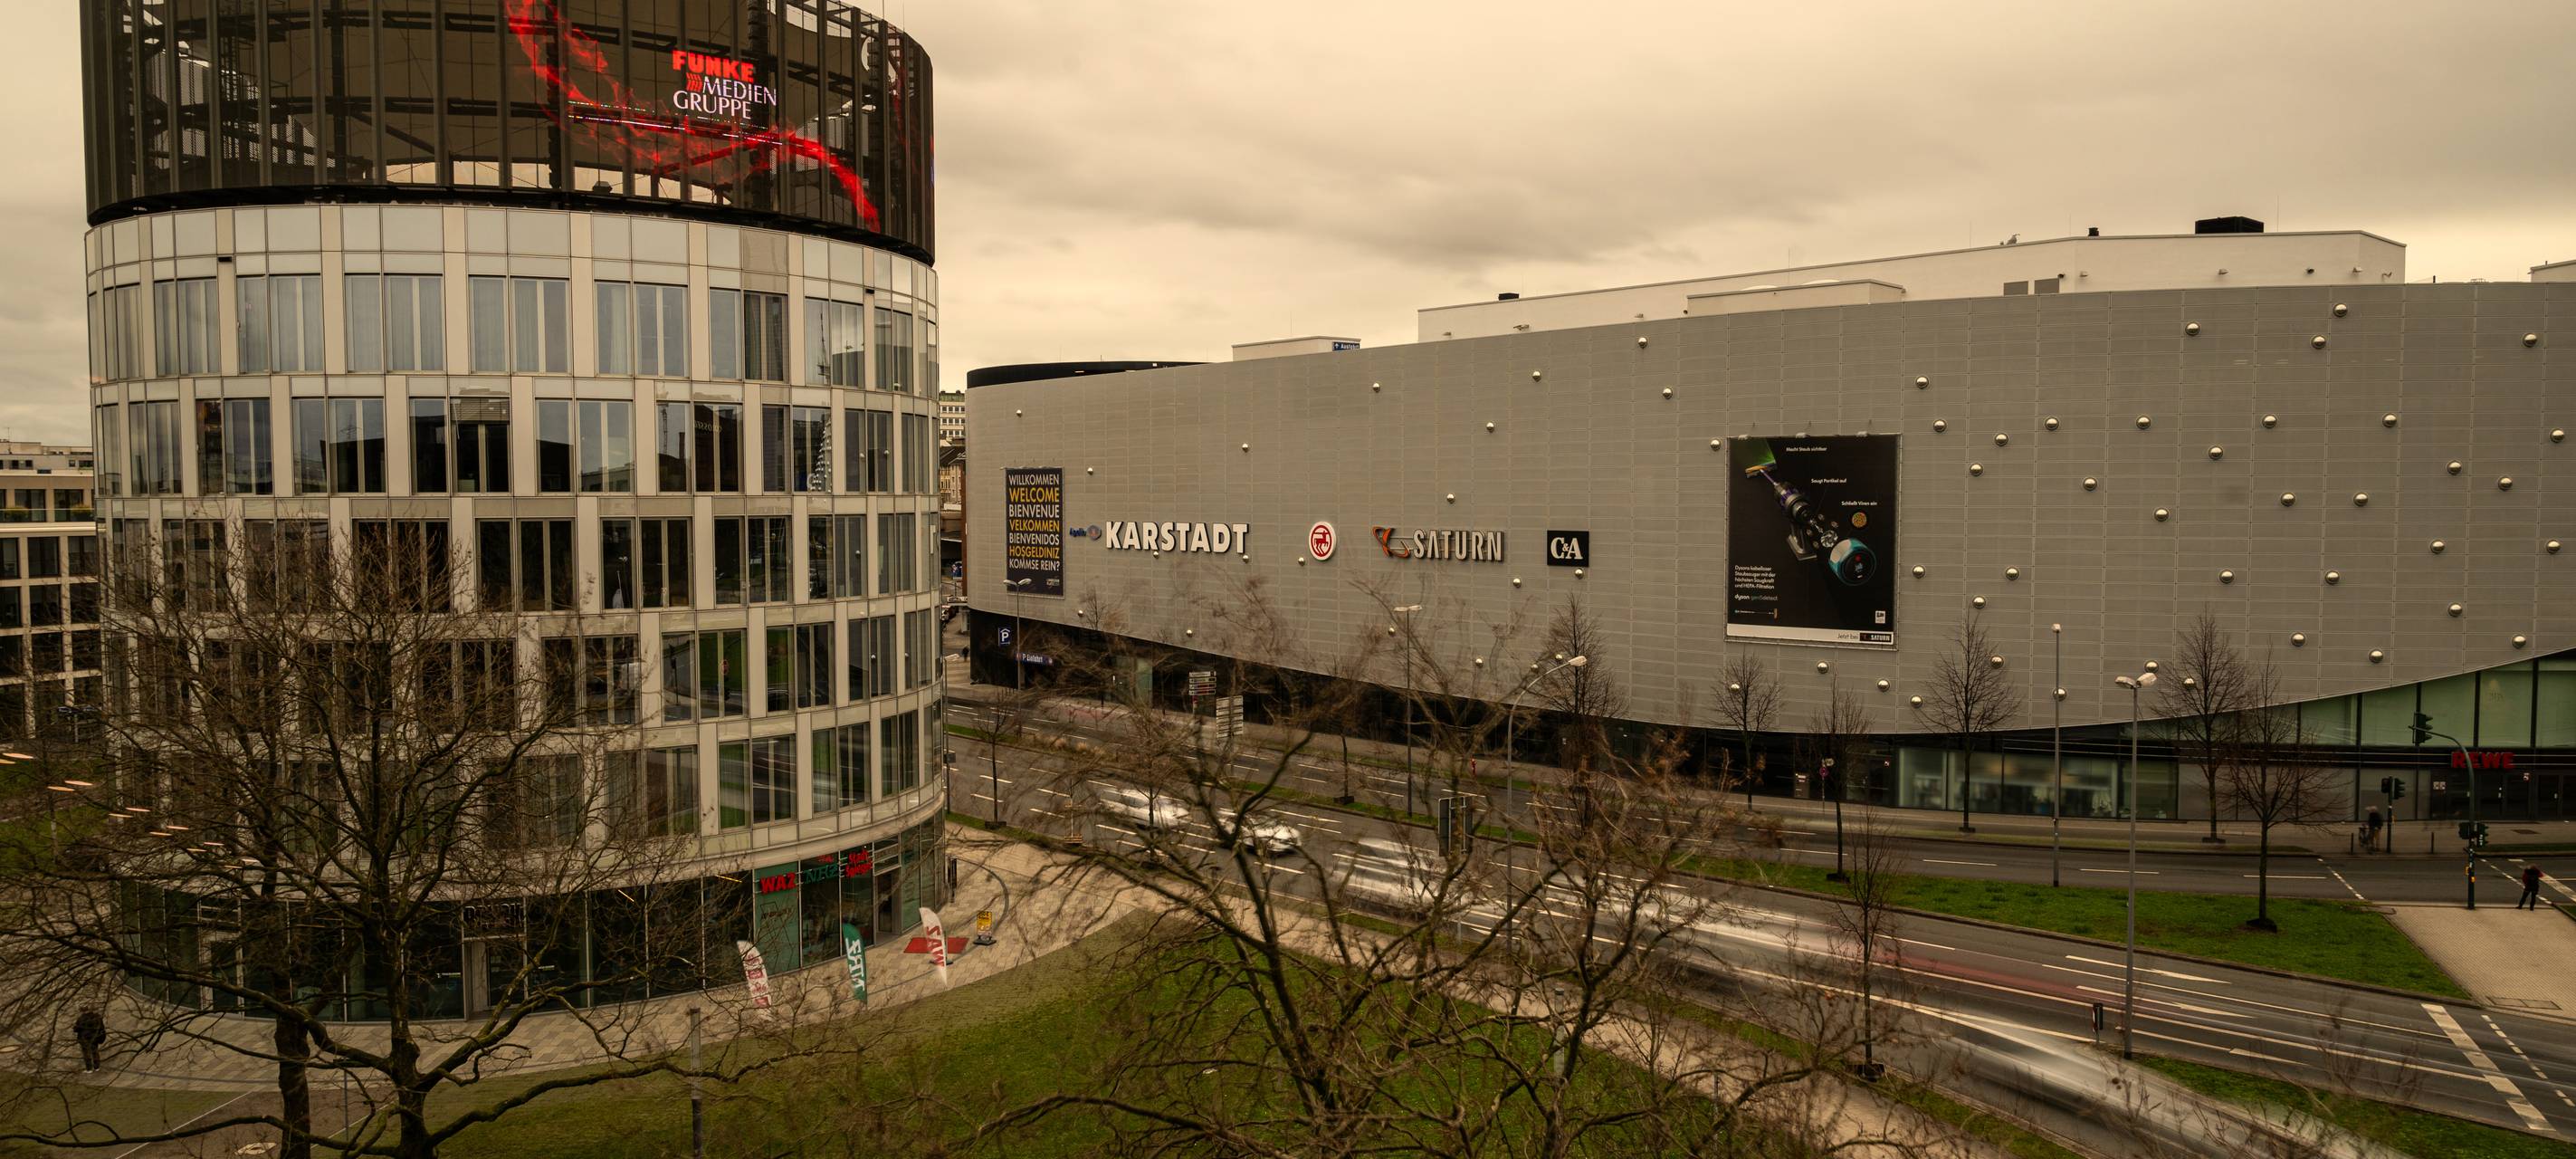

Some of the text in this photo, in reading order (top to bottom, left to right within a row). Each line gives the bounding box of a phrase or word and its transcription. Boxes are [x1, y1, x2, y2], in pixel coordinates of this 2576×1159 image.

[672, 50, 755, 84] FUNKE
[702, 76, 777, 107] MEDIEN
[673, 90, 752, 120] GRUPPE
[1008, 474, 1060, 485] WILLKOMMEN
[1008, 487, 1060, 503] WELCOME
[1008, 504, 1060, 518] BIENVENUE
[1009, 519, 1060, 532] VELKOMMEN
[1008, 532, 1060, 545] BIENVENIDOS
[1105, 521, 1249, 554] KARSTADT
[1413, 528, 1504, 562] SATURN
[1550, 537, 1584, 560] C&A
[1009, 559, 1060, 571] KOMMSE REIN?
[1001, 631, 1009, 642] P
[2451, 751, 2515, 769] REWE
[758, 871, 797, 896] WAZ
